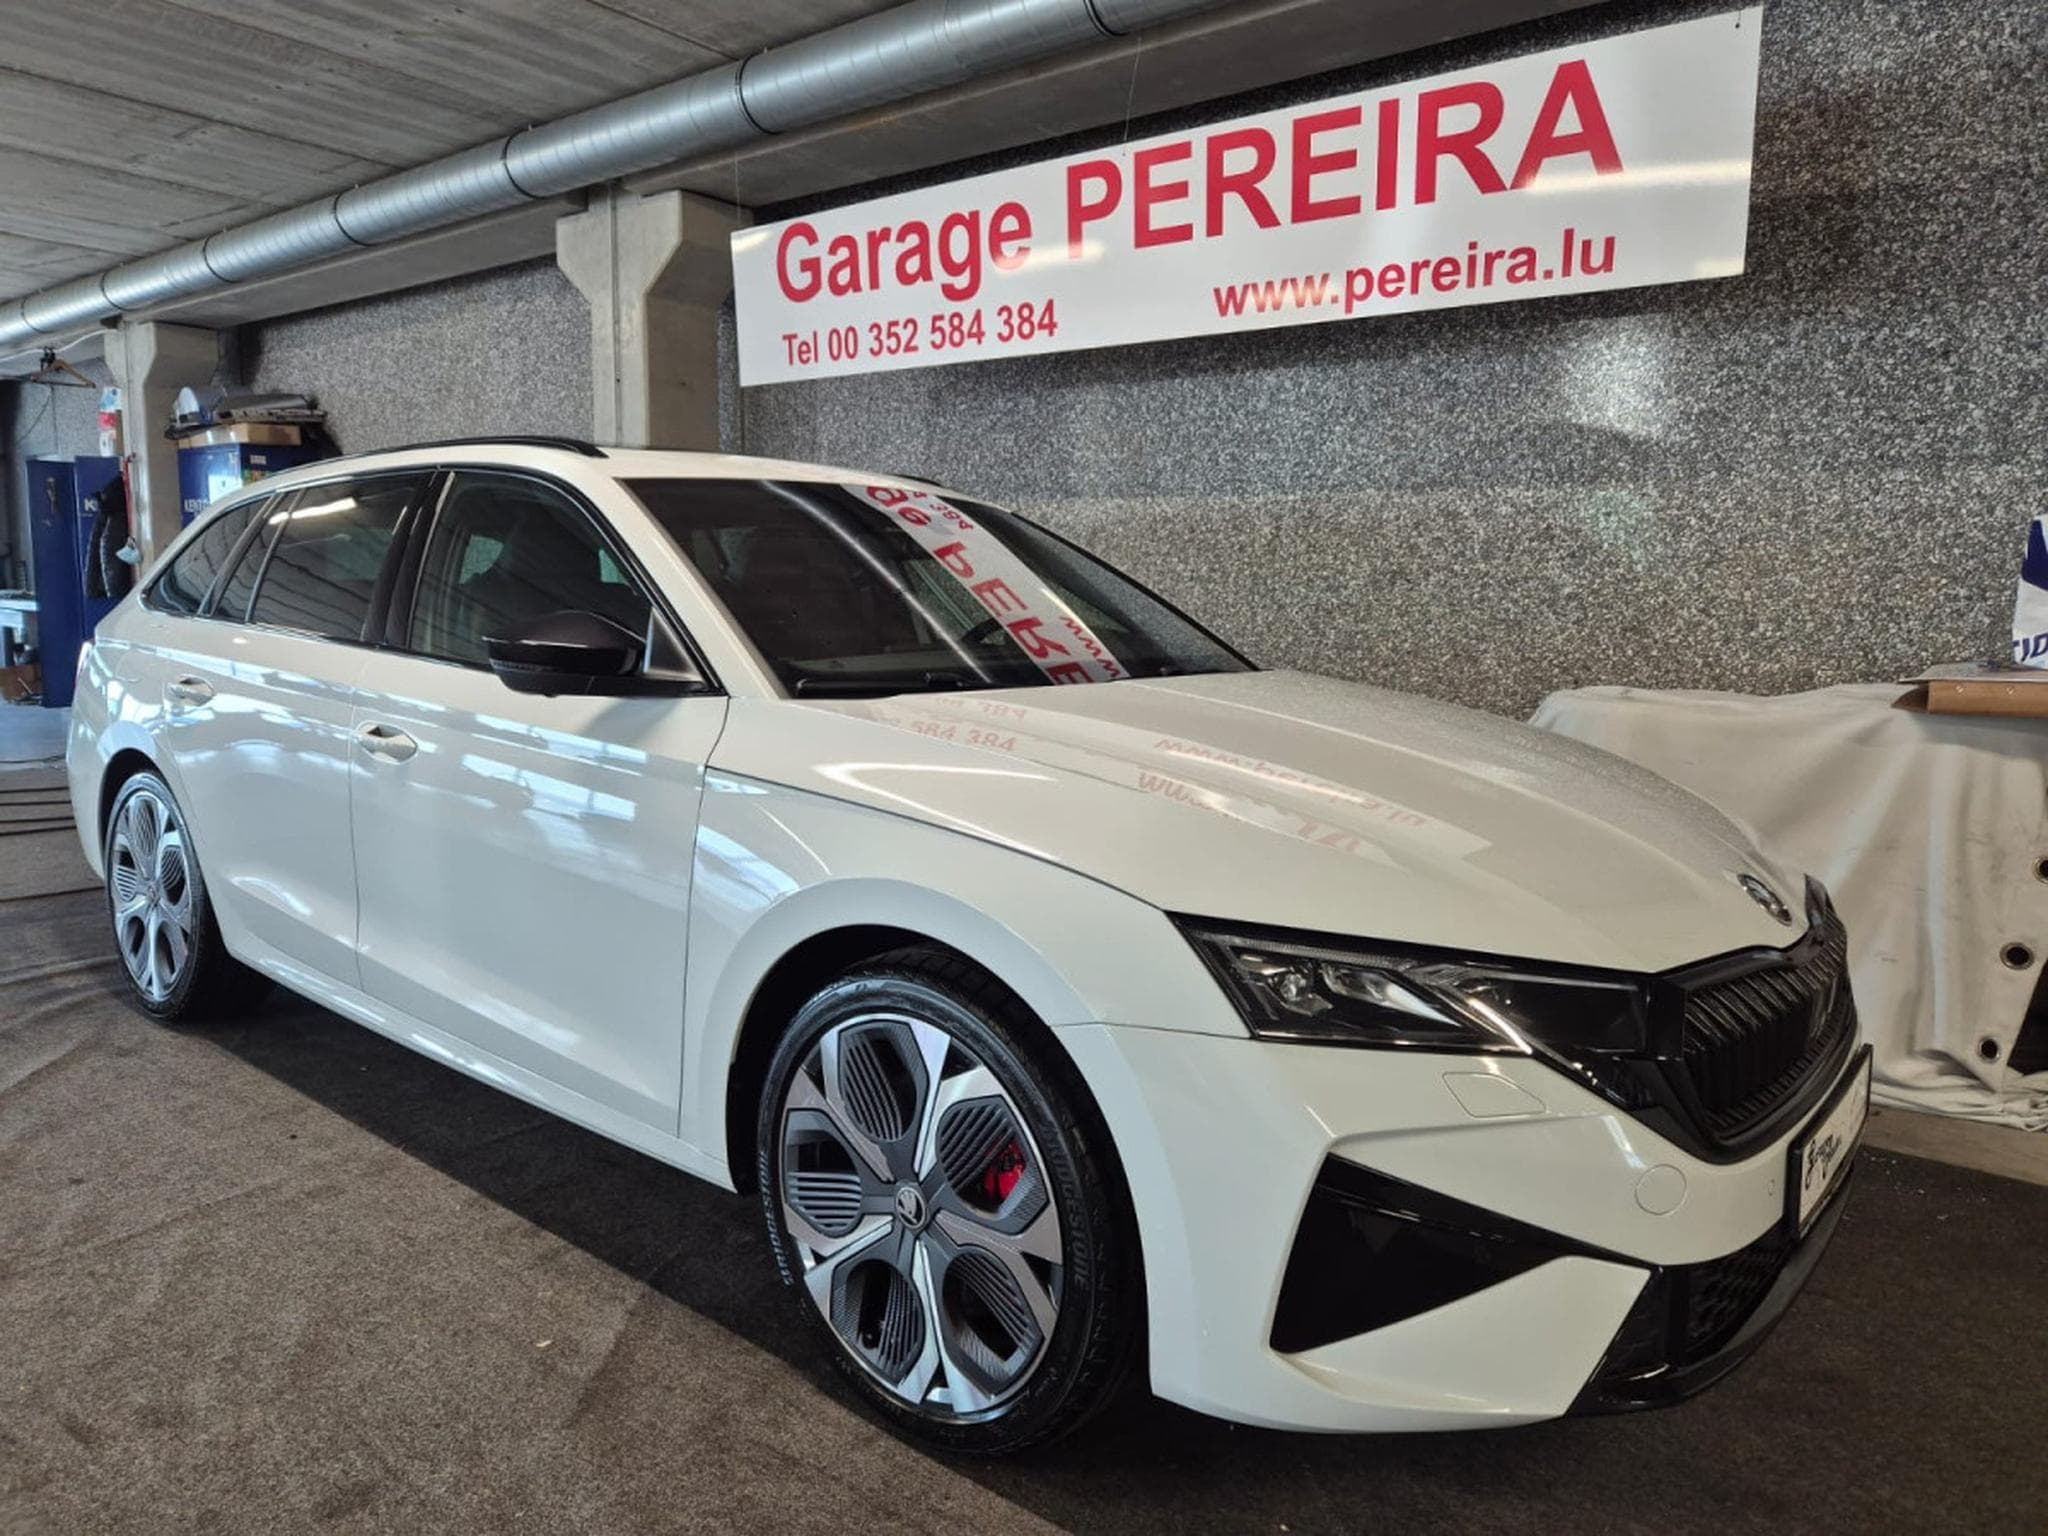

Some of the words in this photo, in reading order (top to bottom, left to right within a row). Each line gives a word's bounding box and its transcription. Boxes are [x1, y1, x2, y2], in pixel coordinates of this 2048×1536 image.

[777, 200, 1034, 305] Garage
[1065, 59, 1625, 260] PEREIRA
[1212, 227, 1617, 319] www.pereira.lu
[782, 331, 819, 365] Tel
[828, 325, 860, 362] 00
[868, 316, 921, 358] 352
[930, 309, 987, 352] 584
[996, 297, 1059, 345] 384
